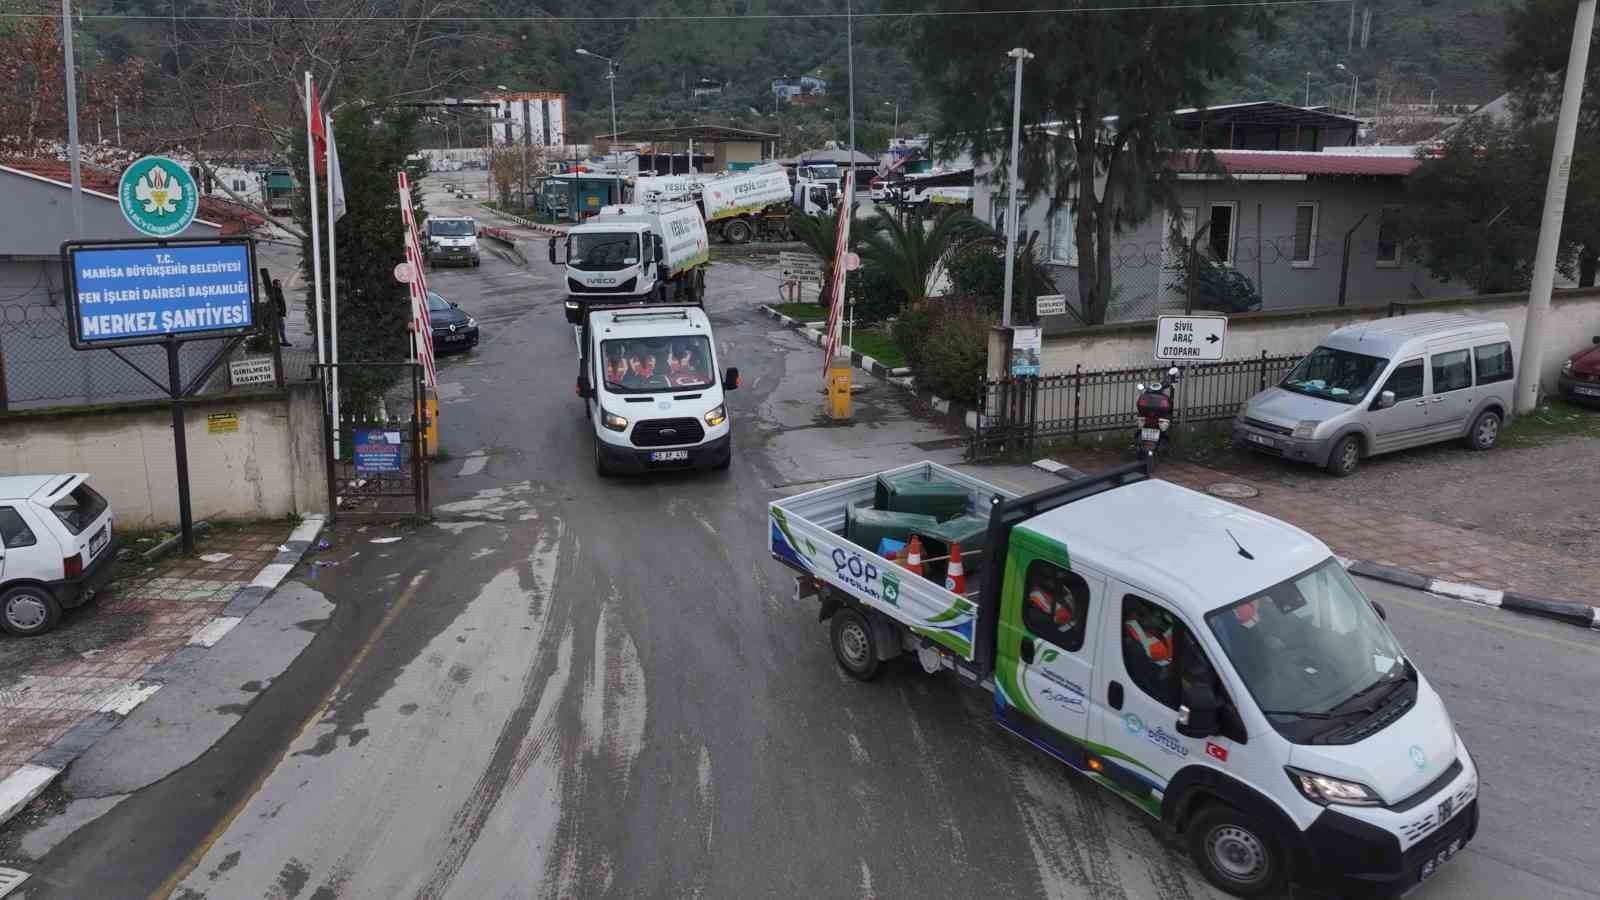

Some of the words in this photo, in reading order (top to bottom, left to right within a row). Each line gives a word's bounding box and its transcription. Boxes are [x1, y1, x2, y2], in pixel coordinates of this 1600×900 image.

[155, 254, 174, 264] T.C.
[82, 266, 125, 280] MANİSA
[126, 262, 189, 278] BÜYÜKŞEHİR
[190, 260, 241, 275] BELEDİYESİ
[78, 292, 101, 304] FEN
[103, 288, 141, 304] İŞLERİ
[143, 284, 186, 300] DAİRESİ
[188, 280, 248, 298] BAŞKANLIĞI
[82, 311, 158, 337] MERKEZ
[161, 300, 248, 333] ŞANTİYESİ
[1174, 320, 1194, 332] SİVİL
[1172, 333, 1193, 345] ARAÇ
[1163, 346, 1201, 357] OTOPARKI
[832, 548, 878, 583] ÇÖP
